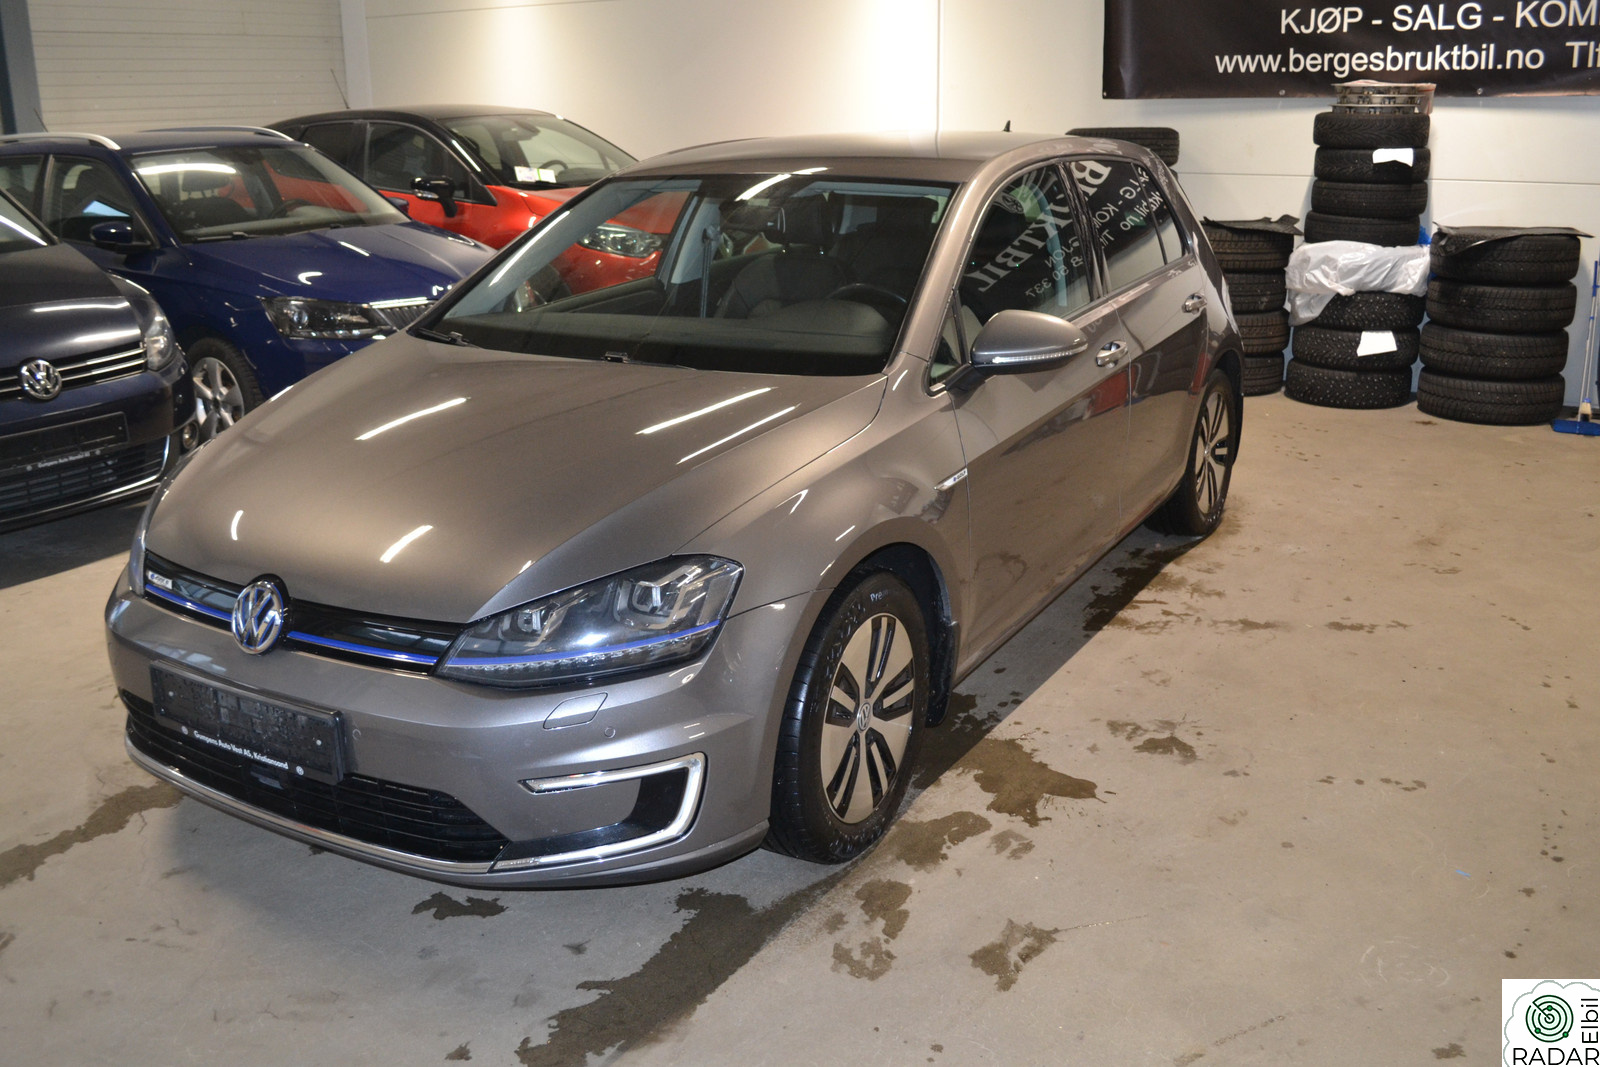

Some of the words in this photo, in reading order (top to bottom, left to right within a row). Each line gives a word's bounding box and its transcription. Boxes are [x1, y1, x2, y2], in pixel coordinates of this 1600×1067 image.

[1280, 6, 1363, 35] KJØP
[1391, 2, 1483, 32] SALG
[1515, 0, 1600, 29] KOM
[1214, 42, 1545, 79] www.bergesbruktbil.no
